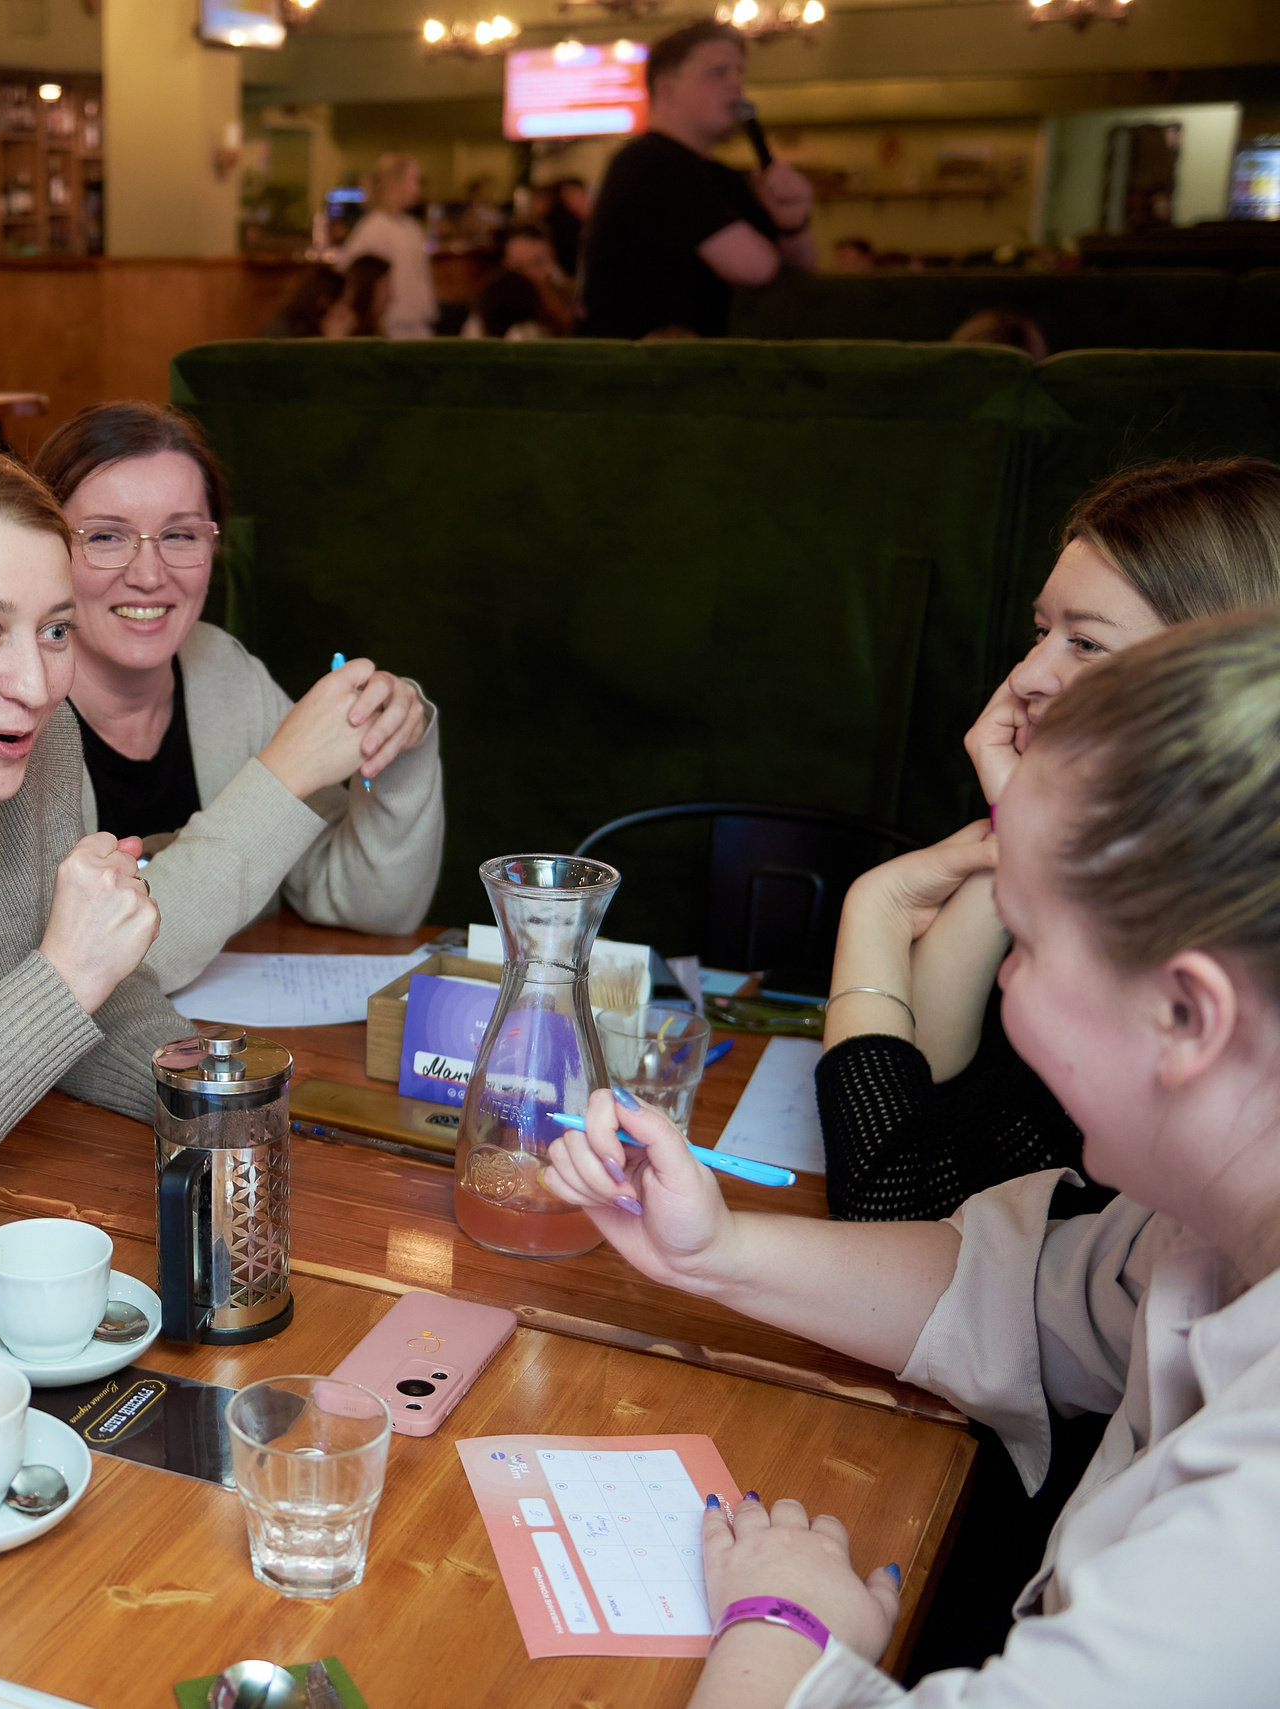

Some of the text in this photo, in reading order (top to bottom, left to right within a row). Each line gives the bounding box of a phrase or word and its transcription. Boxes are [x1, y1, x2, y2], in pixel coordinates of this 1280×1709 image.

[511, 1514, 521, 1527] ТУР
[532, 1566, 564, 1634] НАЗВАНИЕ КОМАНДЫ
[661, 1600, 674, 1618] БЛОК
